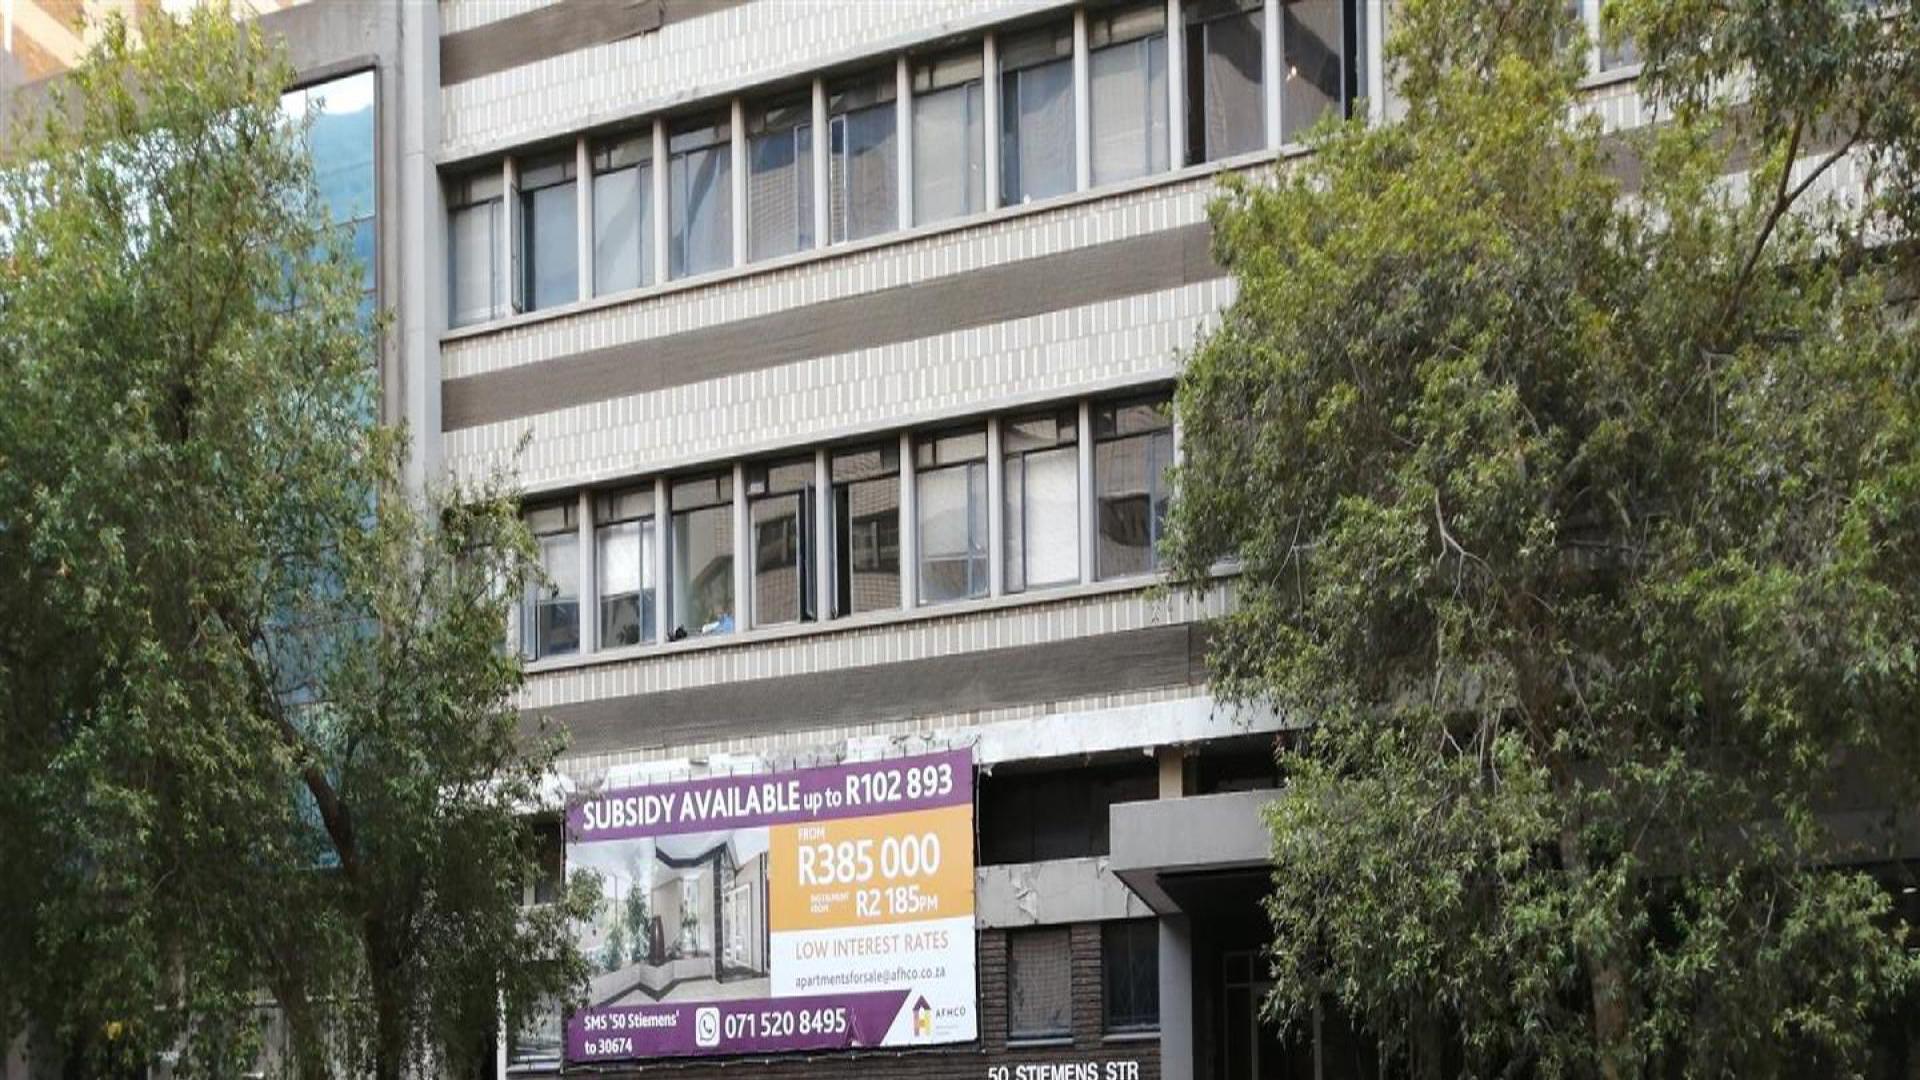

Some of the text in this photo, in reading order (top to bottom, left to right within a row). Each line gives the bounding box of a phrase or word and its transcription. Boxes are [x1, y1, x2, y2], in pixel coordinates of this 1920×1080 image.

[583, 763, 953, 830] SUBSIDY AVAILABLE up to R102 893
[798, 827, 825, 841] FROM
[798, 831, 940, 886] R385 000
[856, 887, 881, 917] R2
[795, 930, 949, 960] LOW INTEREST RATES
[795, 966, 946, 990] apartmentsforsale@afhco.co.za
[584, 1014, 608, 1031] SMS
[725, 1007, 846, 1039] 071 520 8495
[936, 1006, 966, 1018] AFHCO
[584, 1038, 633, 1055] to 30674
[988, 1066, 1009, 1080] 50
[1106, 1061, 1139, 1080] STR
